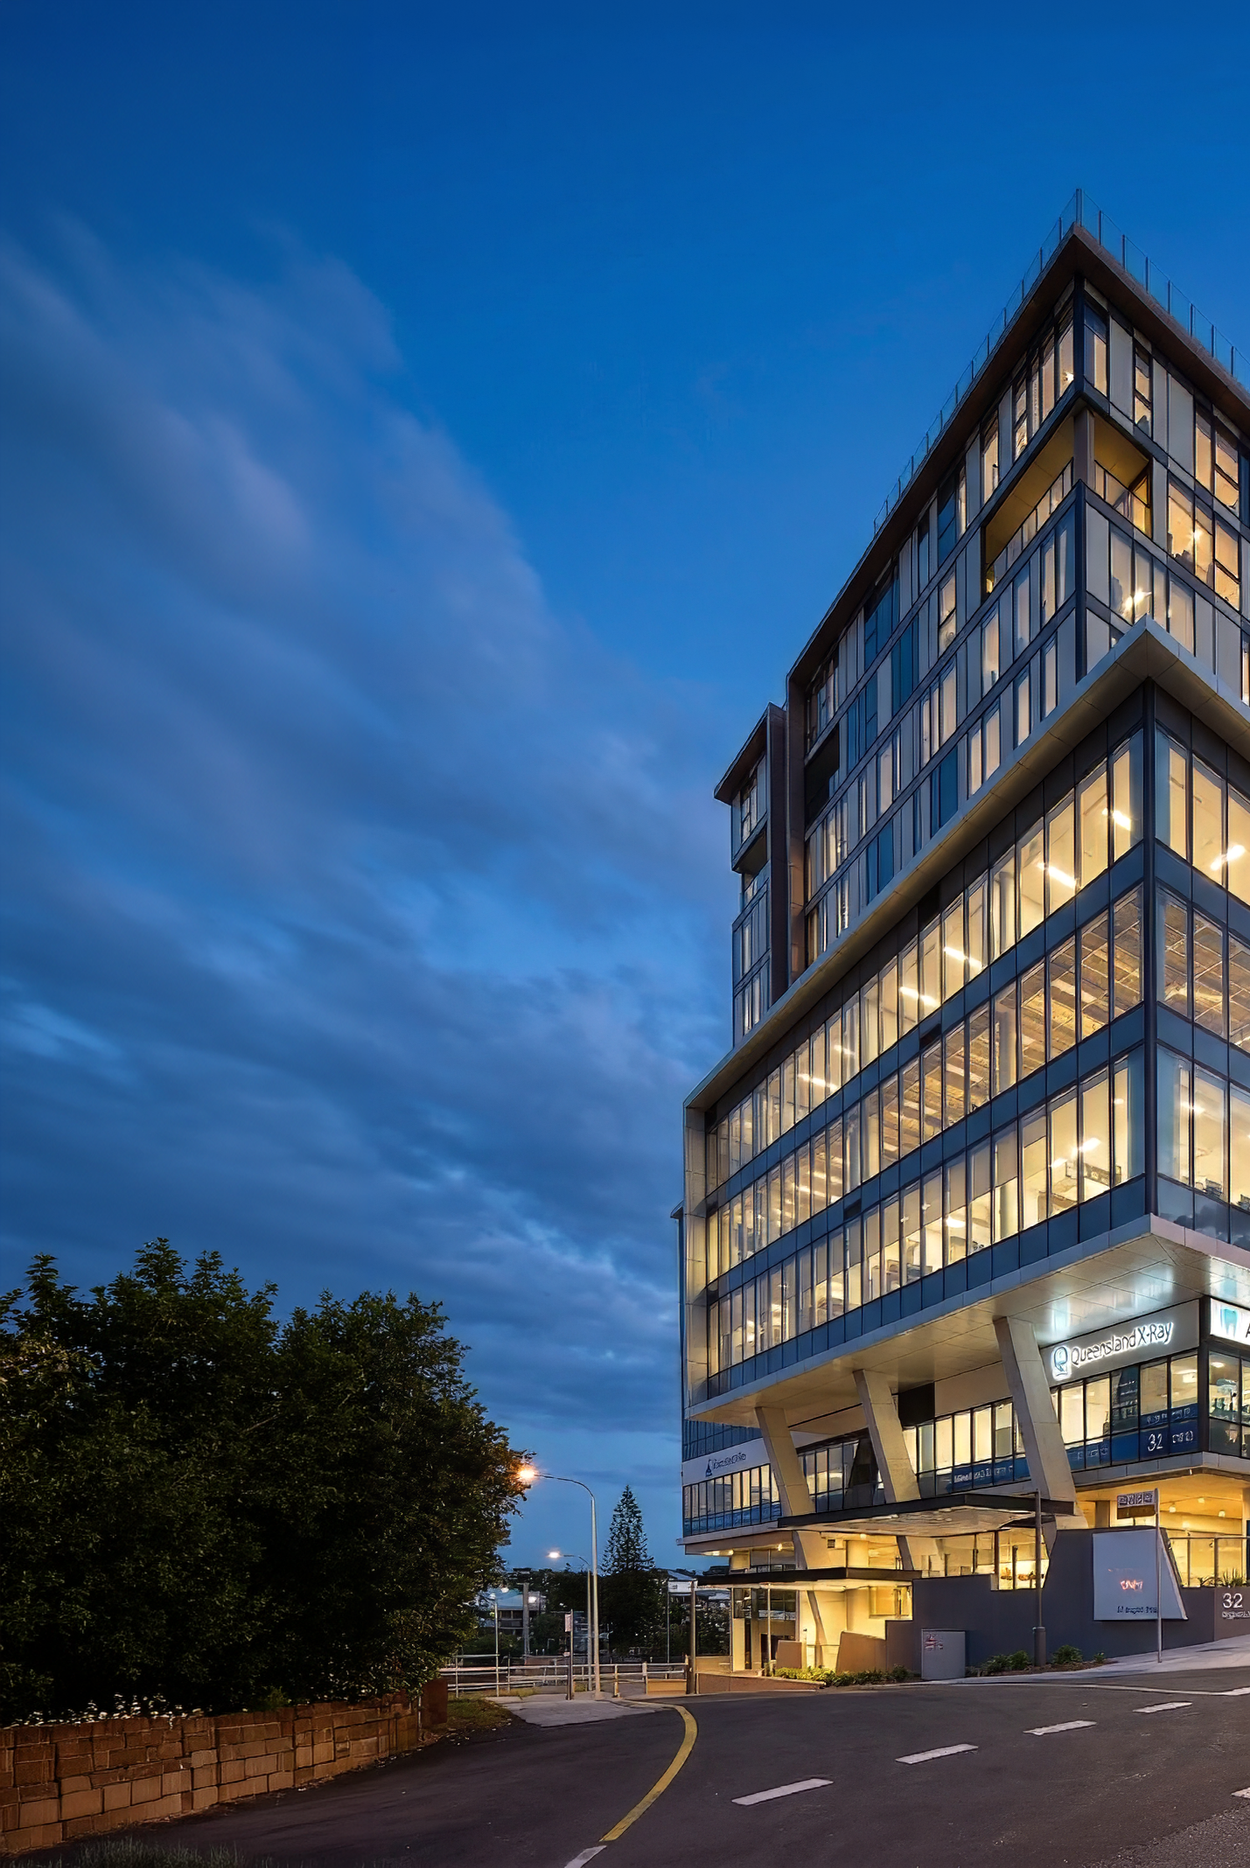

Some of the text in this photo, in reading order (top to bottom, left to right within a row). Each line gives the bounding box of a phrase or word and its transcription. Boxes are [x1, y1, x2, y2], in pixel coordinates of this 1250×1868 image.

[1070, 1322, 1174, 1366] Queensland X-Ray
[1222, 1592, 1244, 1609] 32
